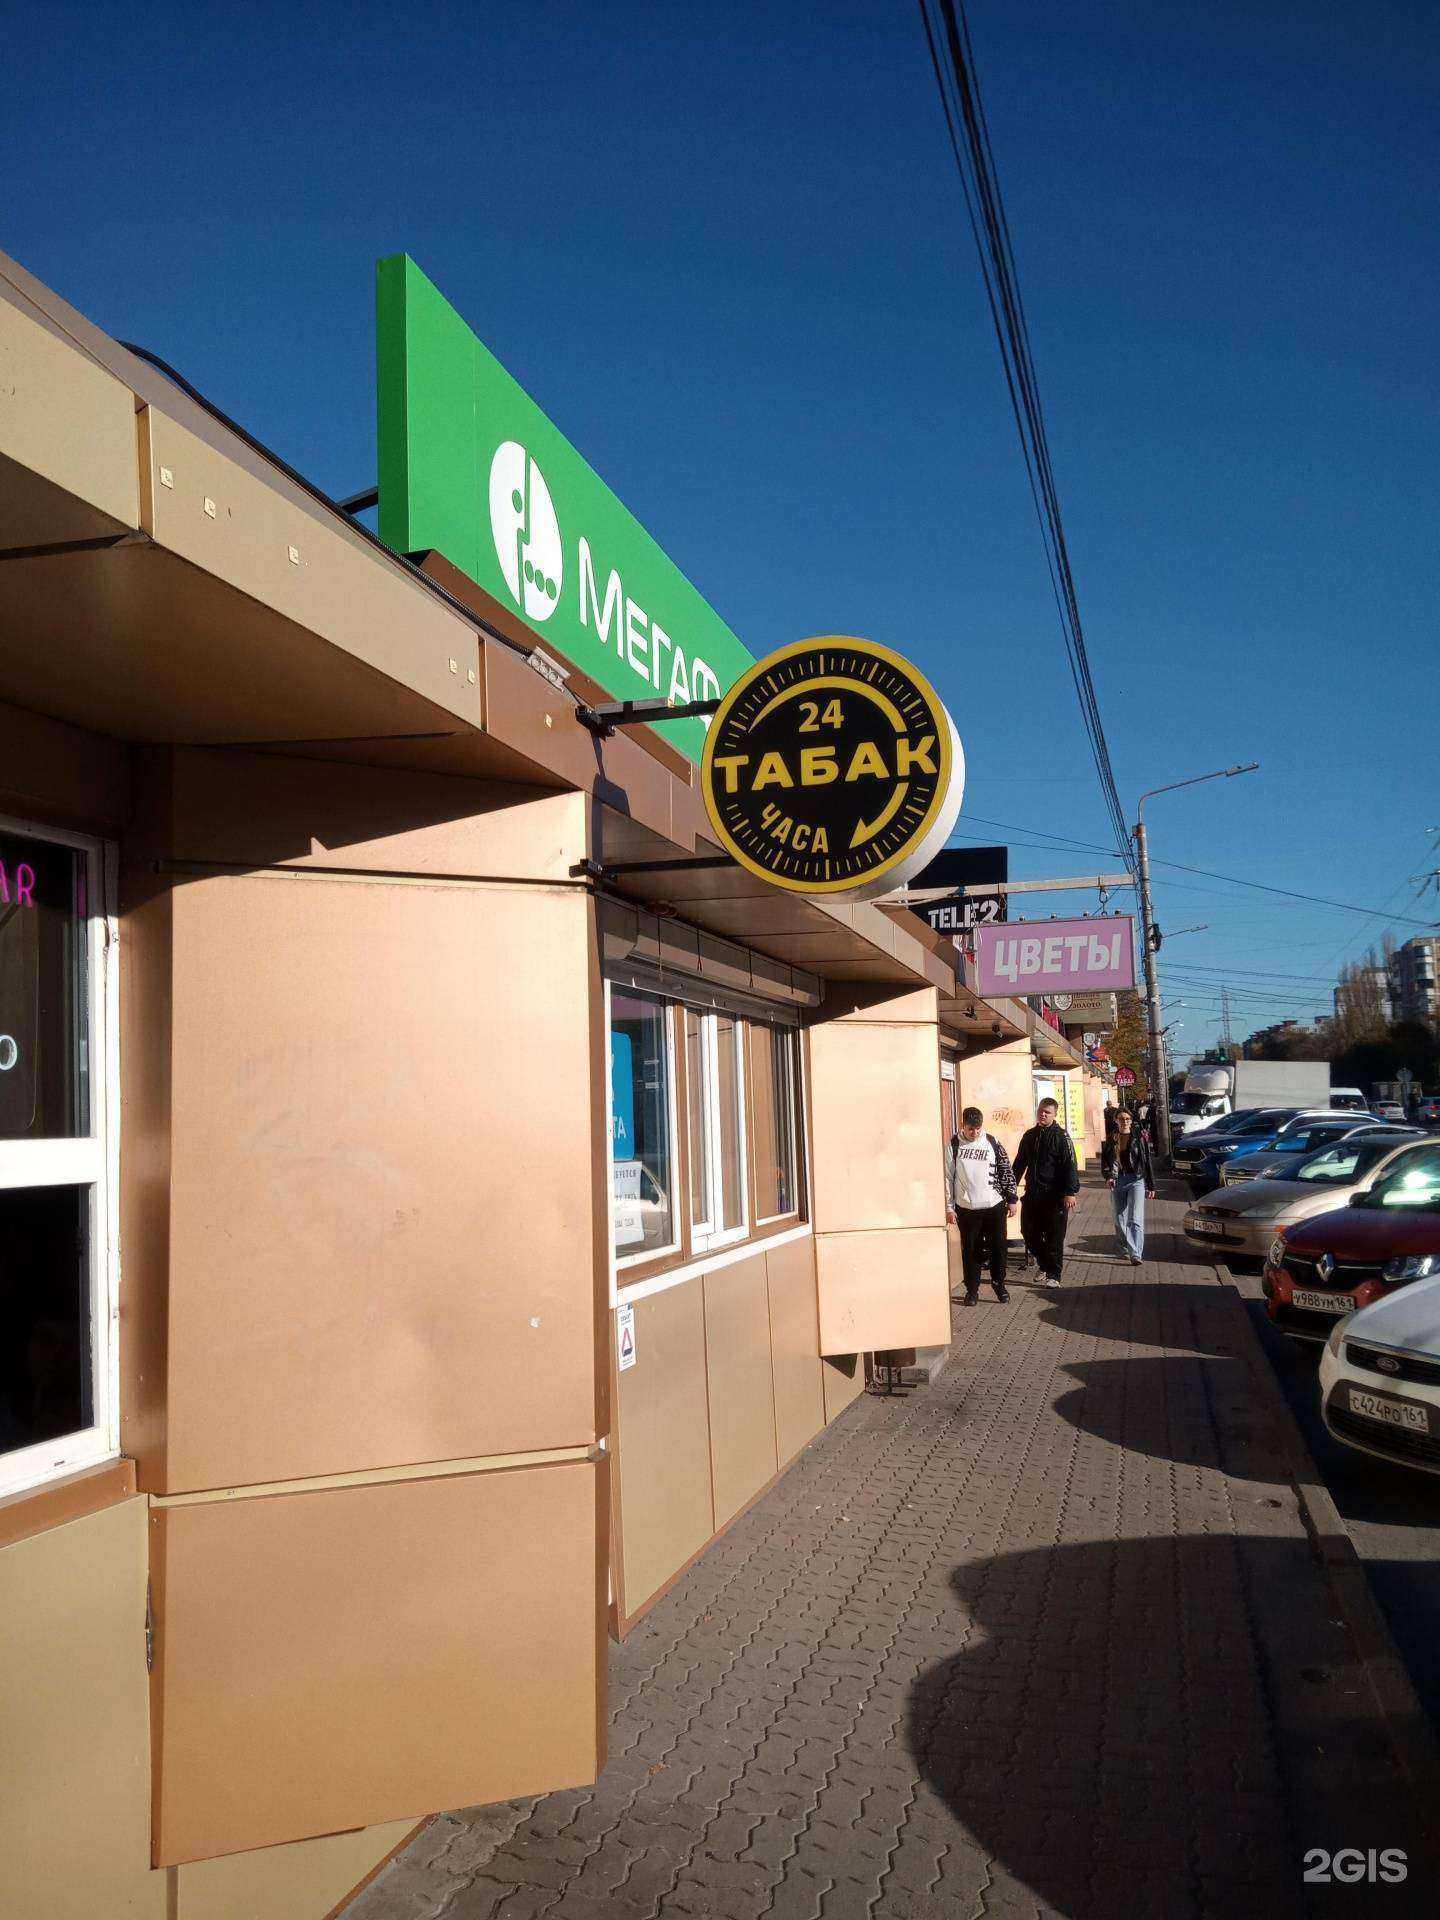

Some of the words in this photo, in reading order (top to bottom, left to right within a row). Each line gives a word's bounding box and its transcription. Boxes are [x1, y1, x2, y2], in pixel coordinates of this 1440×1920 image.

[799, 699, 844, 733] 24
[713, 735, 937, 794] ТАБАК
[762, 803, 829, 854] ЧАСА
[928, 900, 999, 929] TELE2
[994, 934, 1122, 983] ЦВЕТЫ
